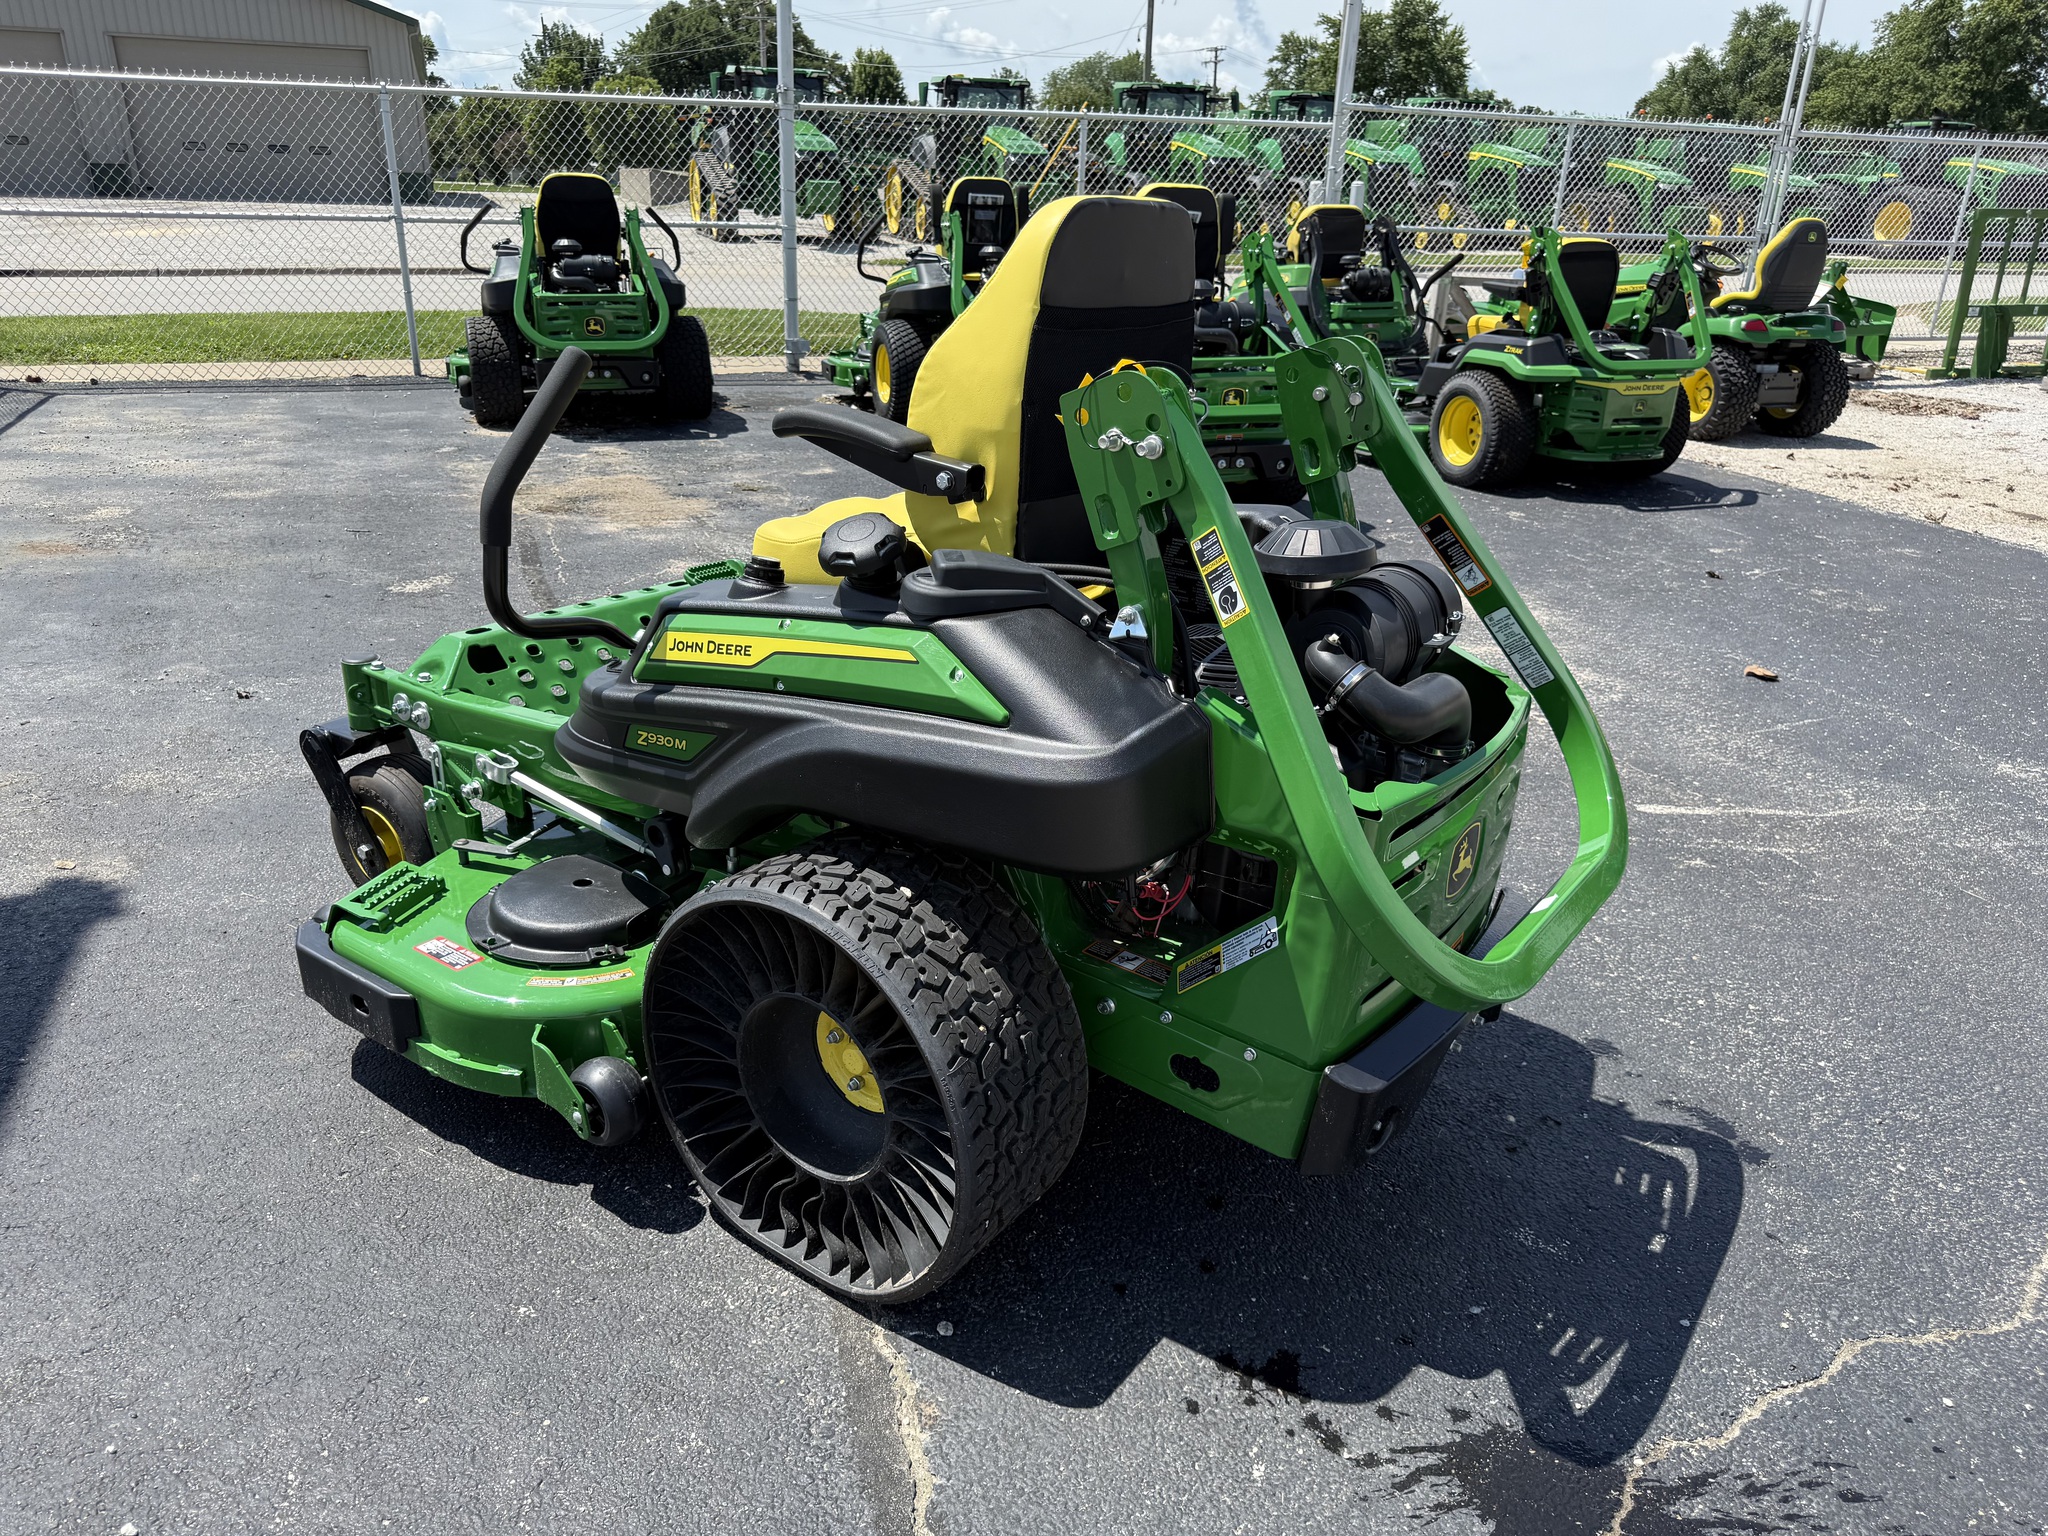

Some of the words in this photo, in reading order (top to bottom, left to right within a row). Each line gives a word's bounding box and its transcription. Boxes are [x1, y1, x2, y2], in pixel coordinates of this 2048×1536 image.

[1623, 384, 1642, 392] JOHN
[668, 637, 704, 654] JOHN
[706, 640, 753, 657] DEERE
[637, 730, 687, 751] Z930M
[823, 926, 886, 979] MICHELIN
